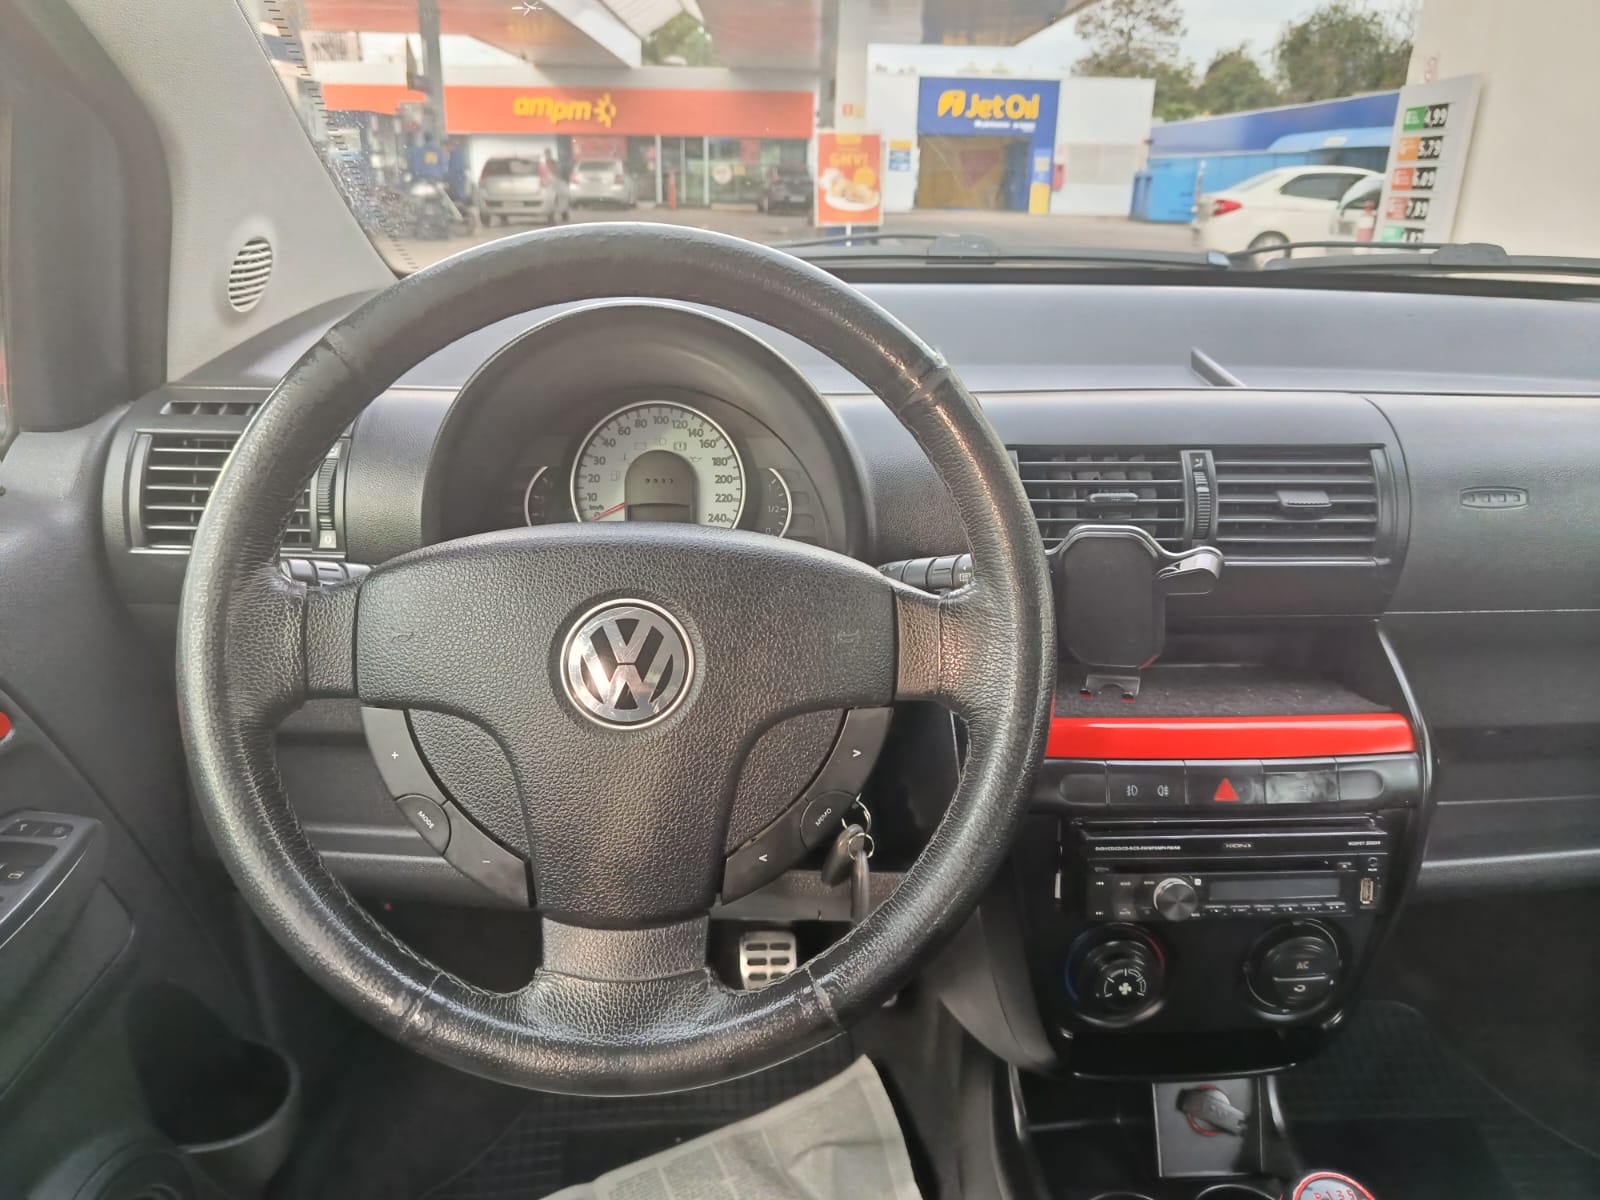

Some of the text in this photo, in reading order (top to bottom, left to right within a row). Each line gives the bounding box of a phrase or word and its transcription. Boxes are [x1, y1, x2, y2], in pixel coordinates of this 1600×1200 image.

[513, 97, 591, 125] ampm
[634, 419, 647, 428] 80
[653, 415, 669, 425] 100
[672, 420, 688, 429] 120
[618, 426, 631, 436] 60
[688, 428, 704, 438] 140
[603, 438, 616, 448] 40
[700, 439, 717, 448] 160
[593, 456, 606, 465] 30
[712, 457, 728, 466] 180
[588, 474, 601, 483] 20
[715, 475, 733, 484] 200
[586, 492, 598, 502] 10
[715, 493, 734, 503] 220
[768, 505, 780, 513] 1/2
[707, 513, 727, 523] 240
[417, 810, 435, 830] MODE
[815, 807, 832, 827] MEMO
[1296, 960, 1310, 970] AC
